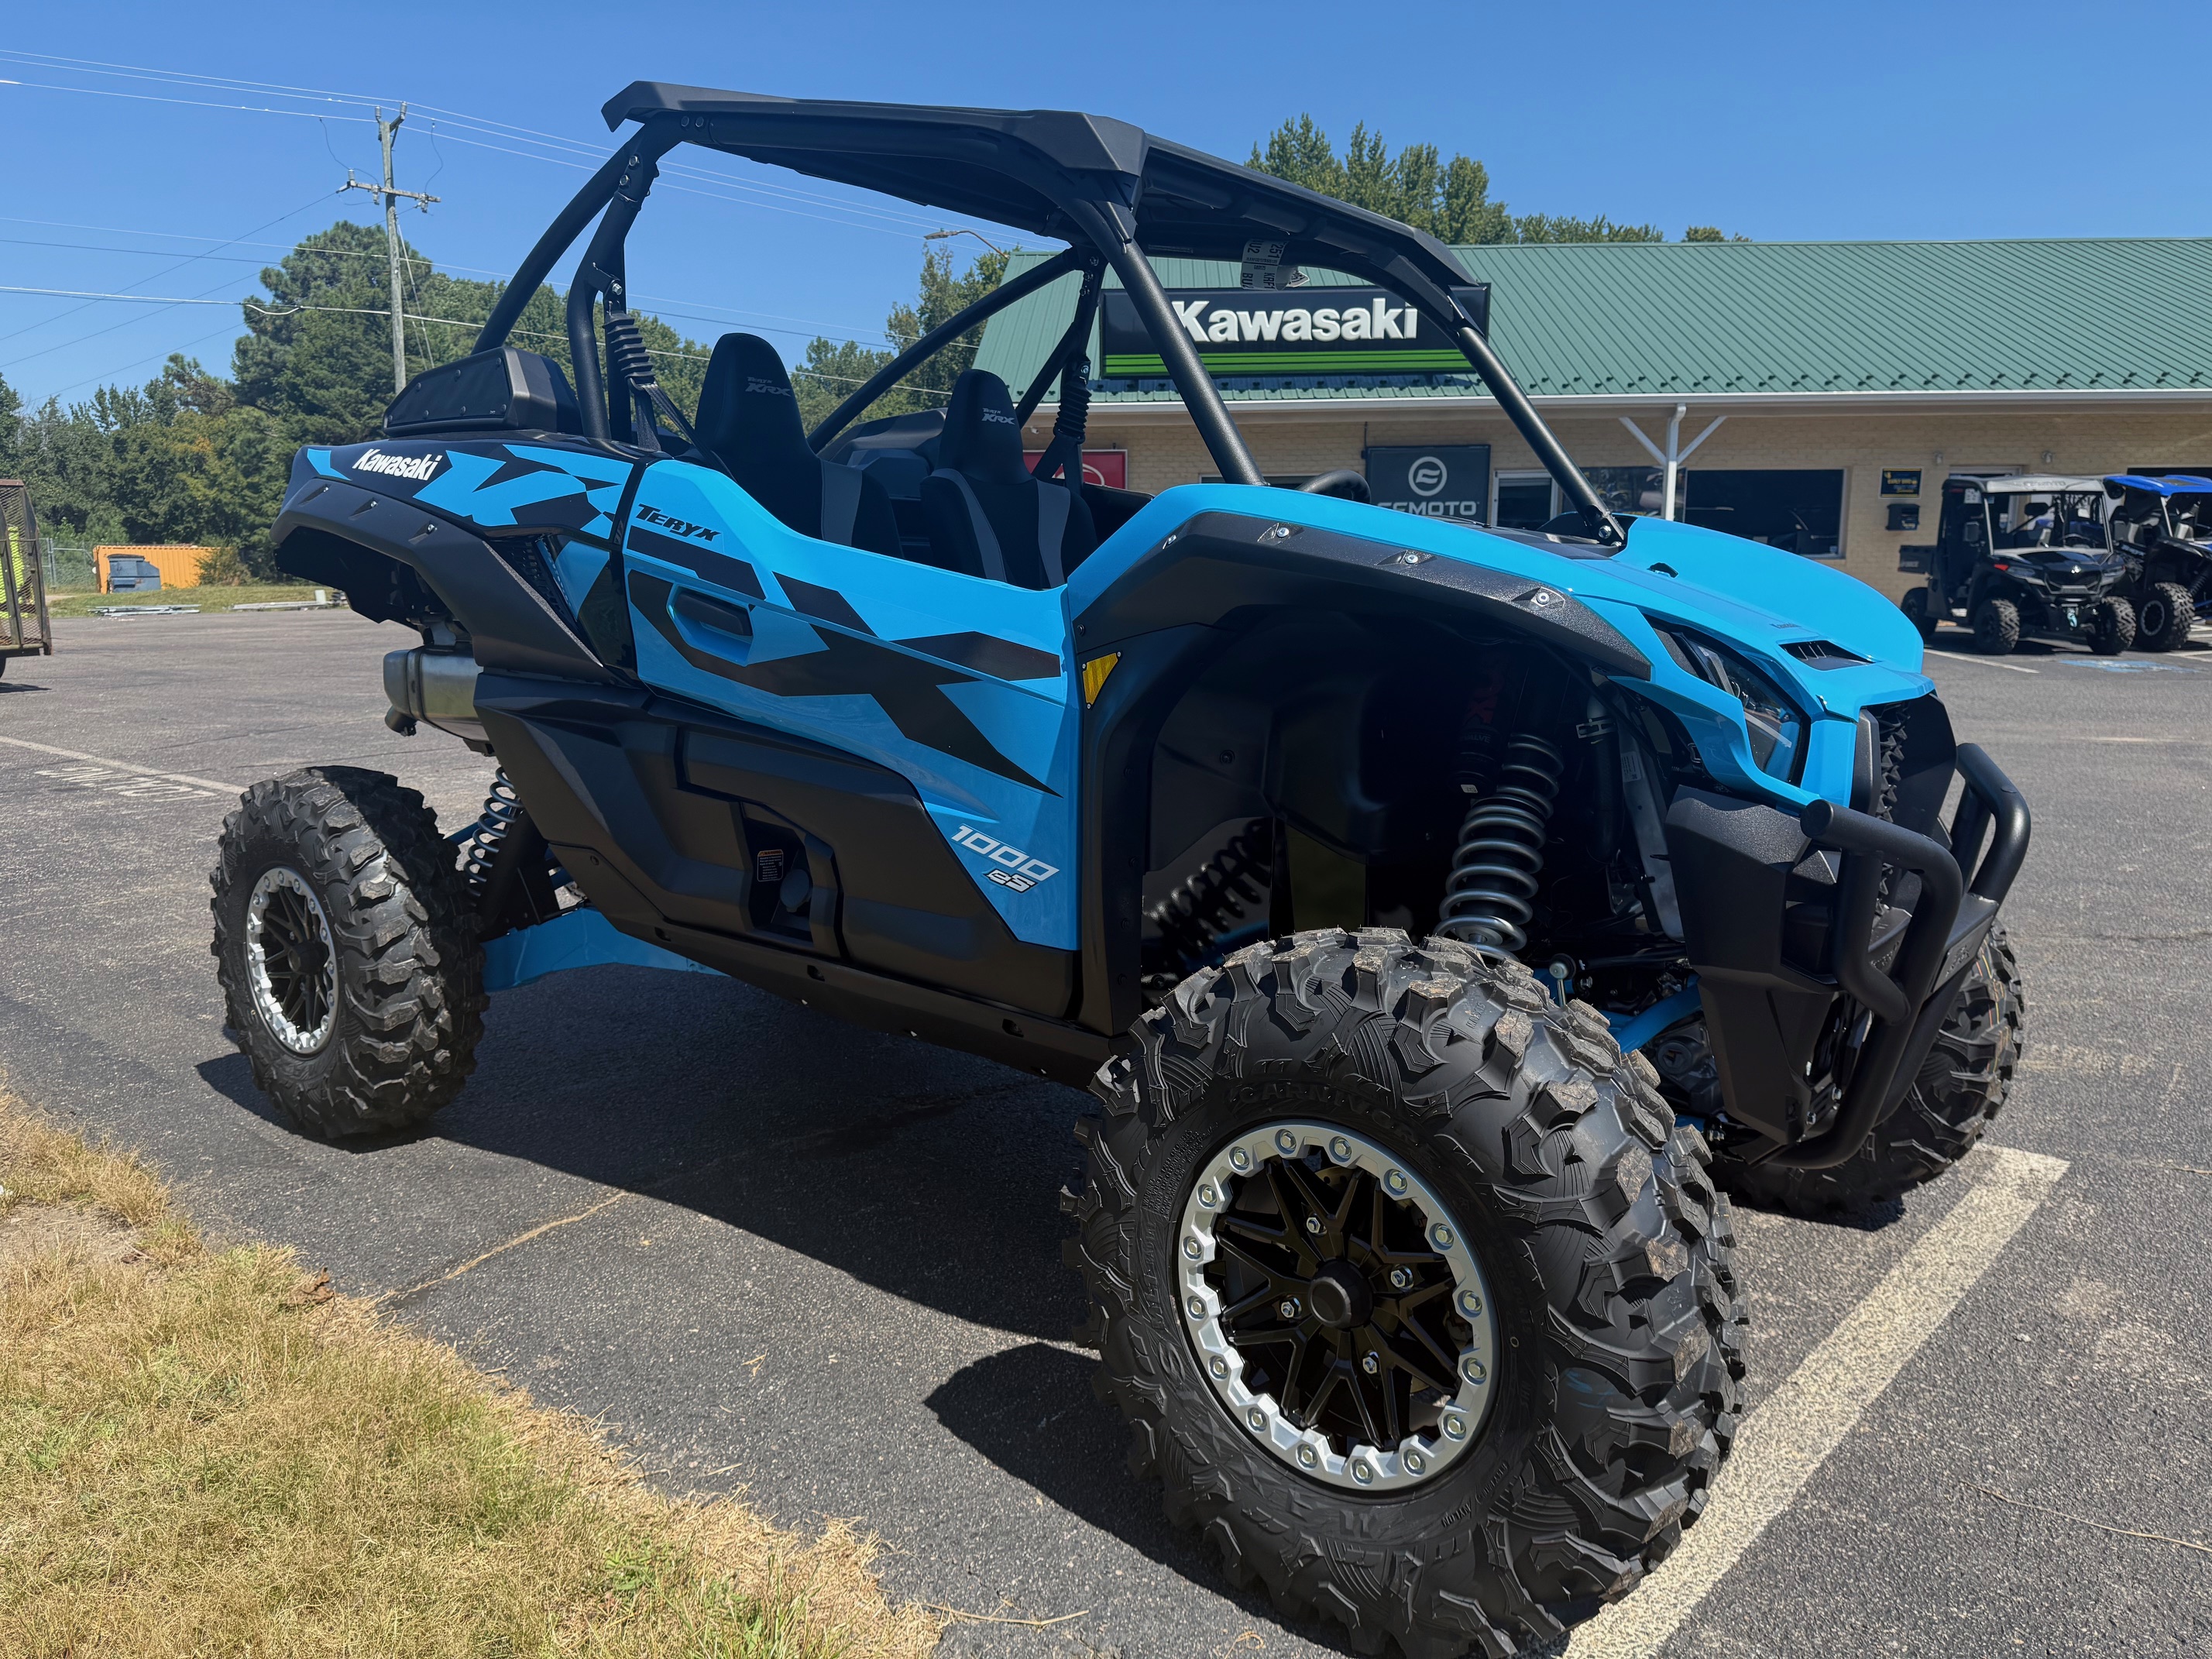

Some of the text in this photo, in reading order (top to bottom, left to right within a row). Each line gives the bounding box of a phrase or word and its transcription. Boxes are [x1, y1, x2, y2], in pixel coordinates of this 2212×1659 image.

[1171, 297, 1417, 342] Kawasaki
[745, 383, 792, 397] KRX
[981, 413, 1015, 425] KRX
[352, 448, 441, 482] Kawasaki
[951, 824, 1060, 881] 1000
